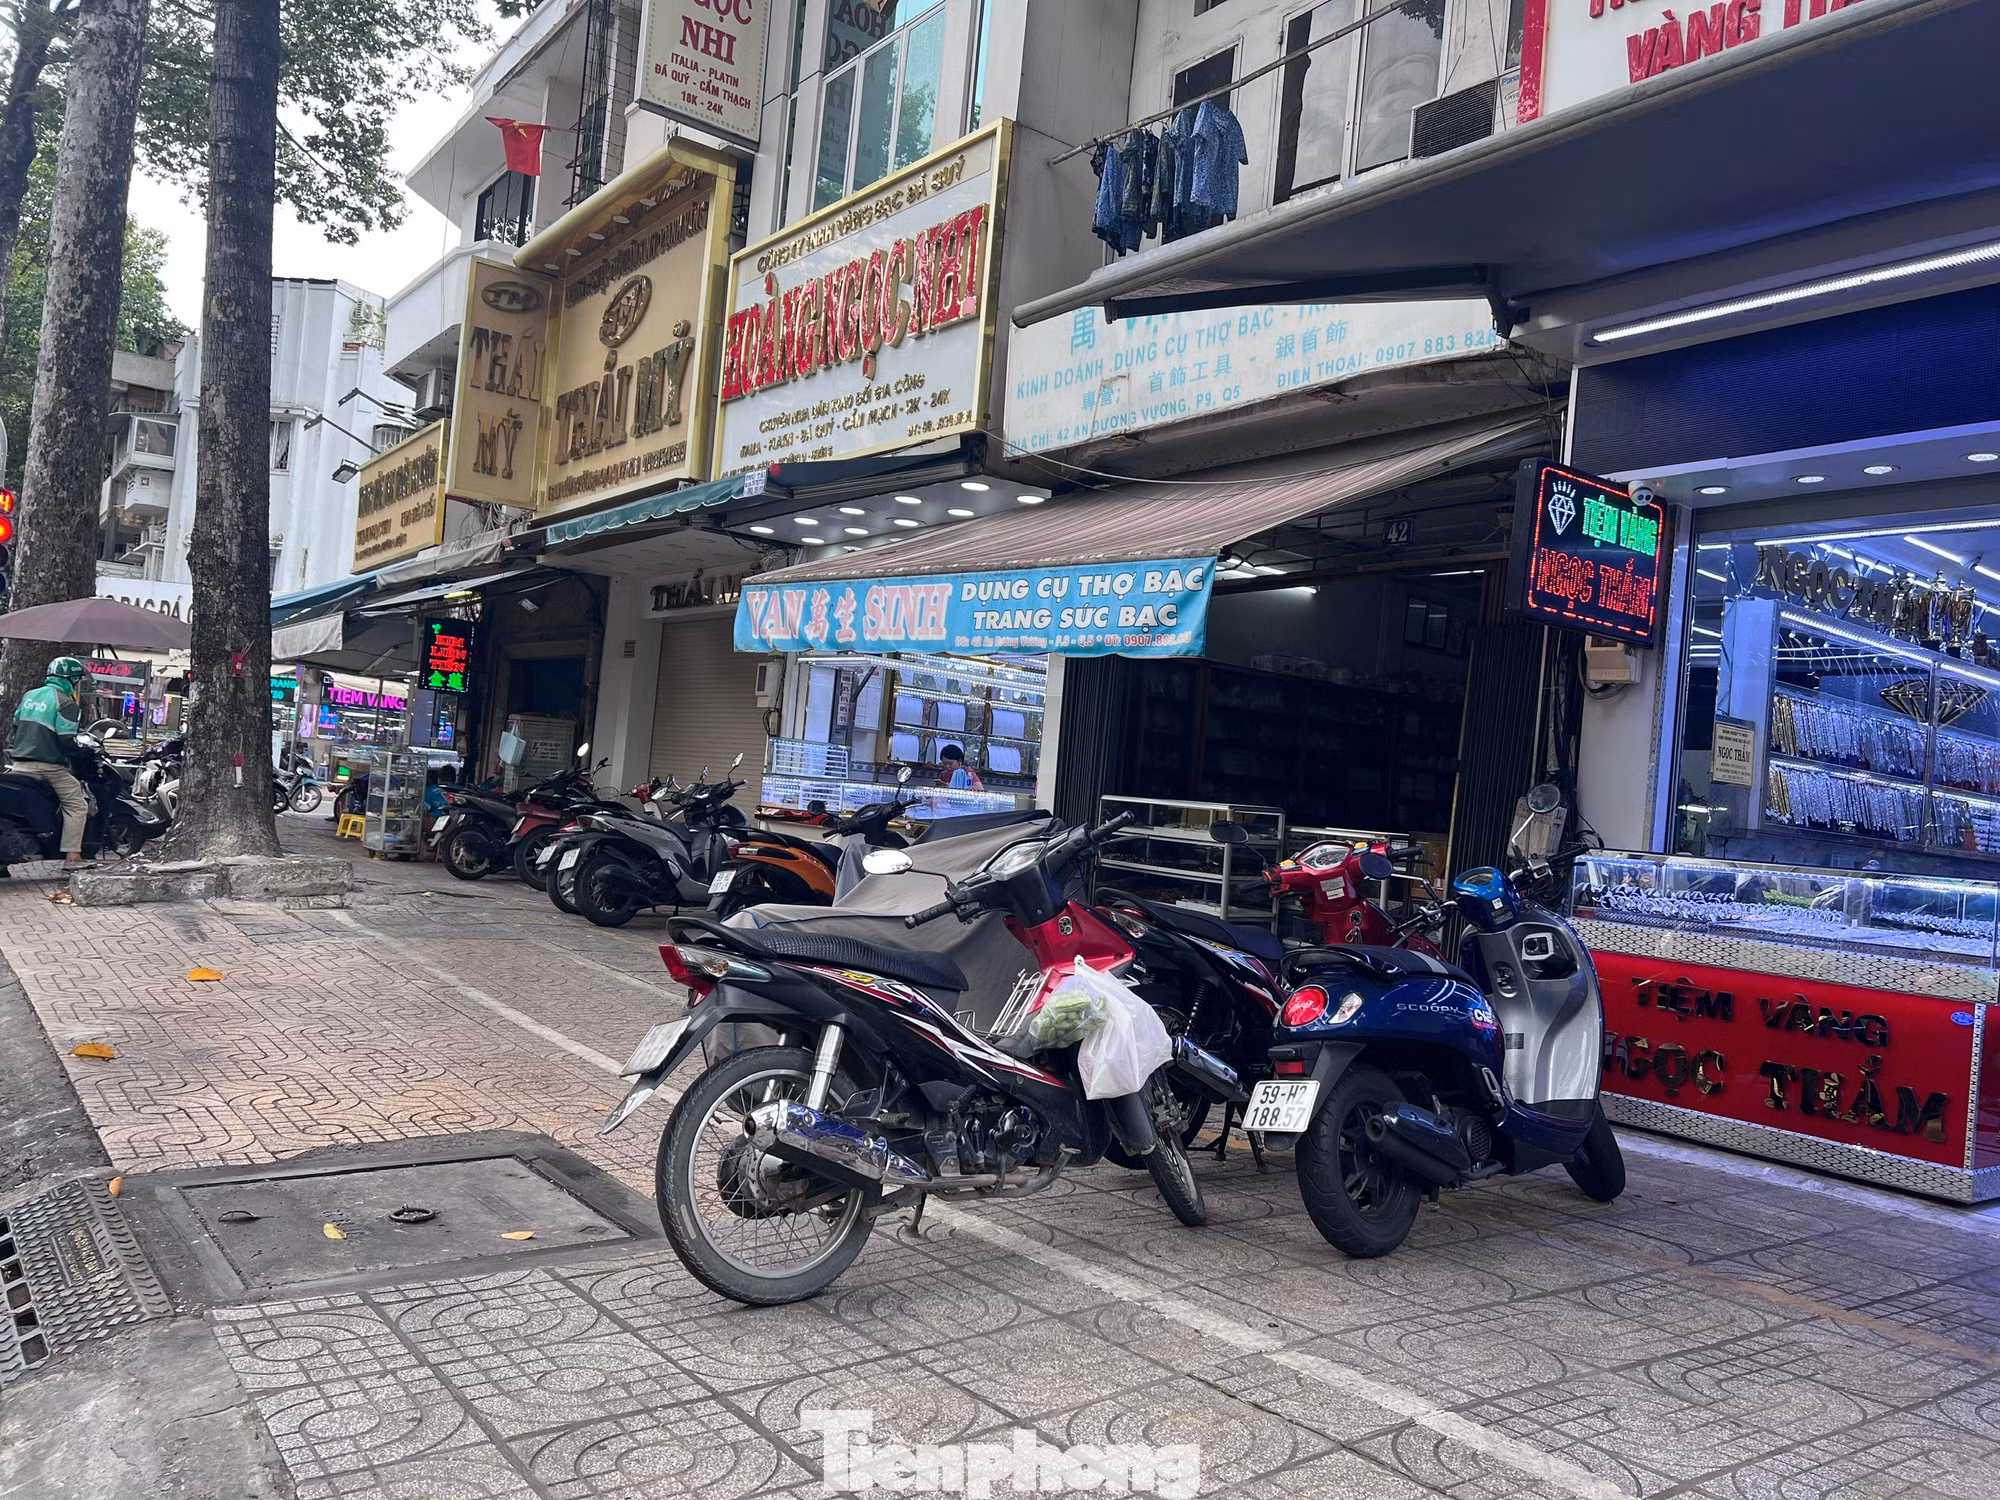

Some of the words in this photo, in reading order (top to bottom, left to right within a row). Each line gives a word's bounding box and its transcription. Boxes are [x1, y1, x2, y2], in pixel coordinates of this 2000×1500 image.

[680, 15, 736, 66] NHI
[1626, 2, 1760, 84] VÀNG
[655, 63, 668, 77] ĐÁ
[671, 70, 689, 85] QUÝ
[700, 80, 719, 97] CẨM
[722, 89, 751, 109] THẠCH
[671, 52, 699, 73] ITALIA
[708, 67, 738, 88] PLATIN
[681, 91, 698, 106] 18K
[707, 101, 723, 115] 24K
[757, 245, 792, 273] CÔNG
[791, 236, 806, 259] TY
[836, 204, 874, 236] VÀNG
[874, 190, 904, 220] BẠC
[906, 172, 928, 204] ĐÁ
[931, 154, 965, 190] QUÝ
[722, 271, 822, 400] HOÀNG
[818, 238, 913, 380] NGỌC
[907, 203, 989, 339] NHI
[470, 327, 546, 401] THÁI
[1017, 374, 1048, 400] KINH
[1054, 361, 1103, 389] DOANH
[1165, 333, 1188, 358] CỤ
[1196, 323, 1232, 348] THỢ
[1238, 307, 1274, 336] BẠC
[1376, 342, 1415, 363] 0907
[1424, 334, 1455, 355] 883
[555, 350, 633, 465] THÁI
[630, 319, 695, 438] MỸ
[874, 383, 891, 400] GIA
[894, 372, 925, 395] CÔNG
[814, 416, 835, 438] QUÝ
[930, 387, 951, 408] 24K
[1057, 427, 1069, 440] 42
[1073, 423, 1088, 440] AN
[1093, 411, 1137, 435] DƯƠNG
[1222, 387, 1240, 402] Q5
[472, 407, 523, 480] MỸ
[1387, 521, 1408, 543] 42
[1582, 494, 1619, 547] TIỆM
[1619, 506, 1658, 556] VÀNG
[649, 567, 716, 611] THÁI
[961, 579, 1030, 606] DỤNG
[1036, 577, 1070, 603] CỤ
[1078, 572, 1136, 600] THỢ
[1143, 567, 1205, 598] BẠC
[1536, 547, 1595, 609] NGỌC
[747, 590, 806, 649] VẠN
[804, 587, 857, 644] 萬生
[863, 583, 952, 641] SINH
[973, 608, 1053, 630] TRANG
[1059, 603, 1110, 629] SỨC
[1117, 604, 1178, 633] BẠC
[23, 698, 47, 713] Grab
[1396, 1003, 1459, 1013] SCOOPY
[1631, 975, 1734, 1022] TIỆM
[1759, 993, 1889, 1048] VÀNG
[1251, 1107, 1306, 1128] 188.57
